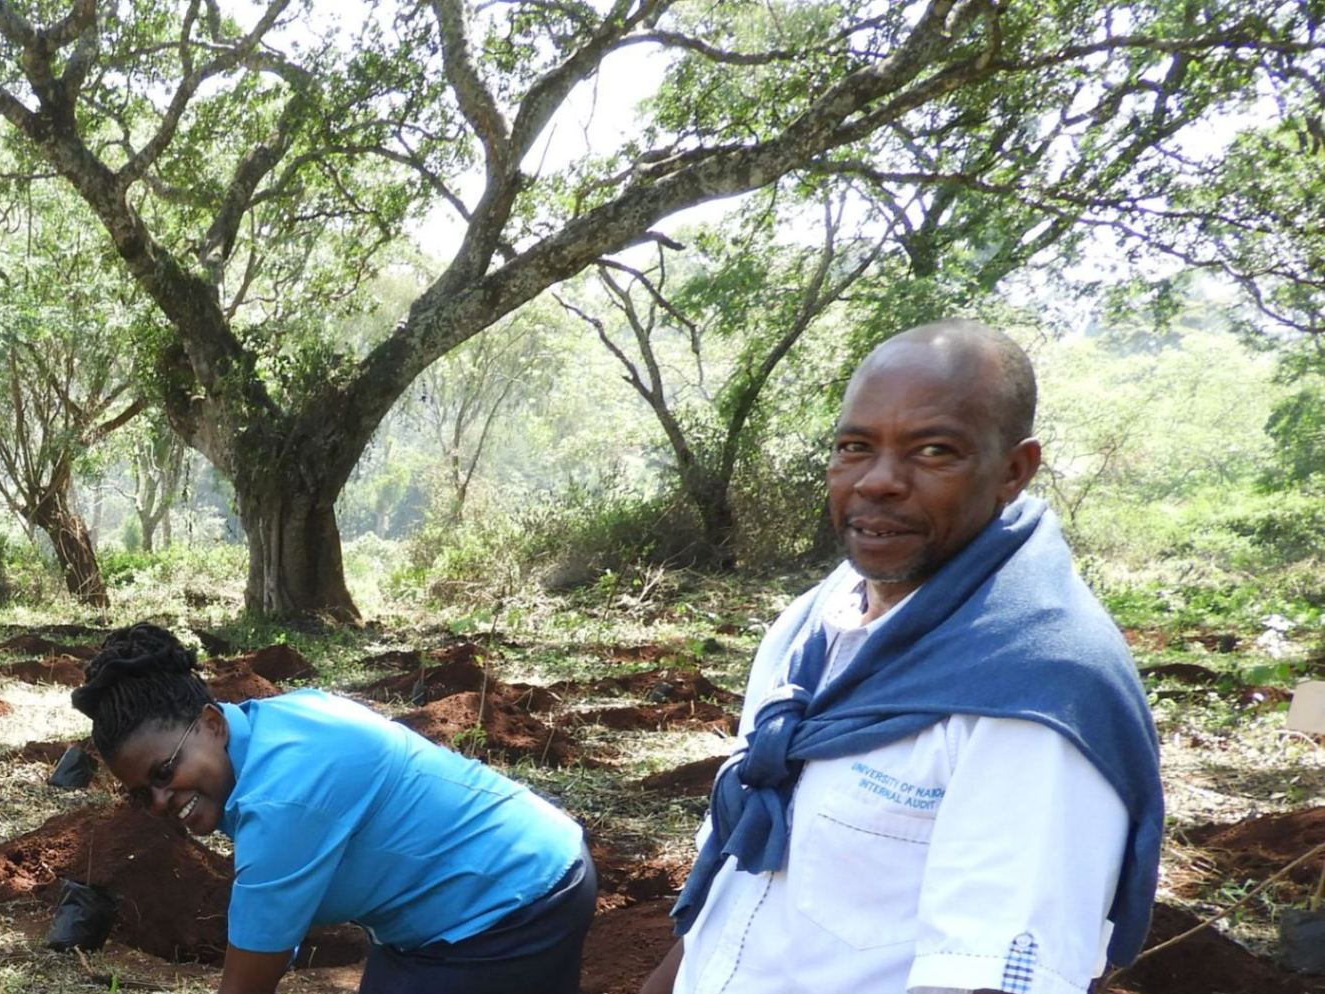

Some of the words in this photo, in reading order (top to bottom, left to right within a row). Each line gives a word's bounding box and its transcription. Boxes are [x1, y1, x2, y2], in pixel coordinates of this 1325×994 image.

[851, 762, 899, 788] UNIVERSITY
[900, 782, 915, 794] OF
[859, 779, 902, 803] INTERNAL
[904, 797, 936, 810] AUDIT
